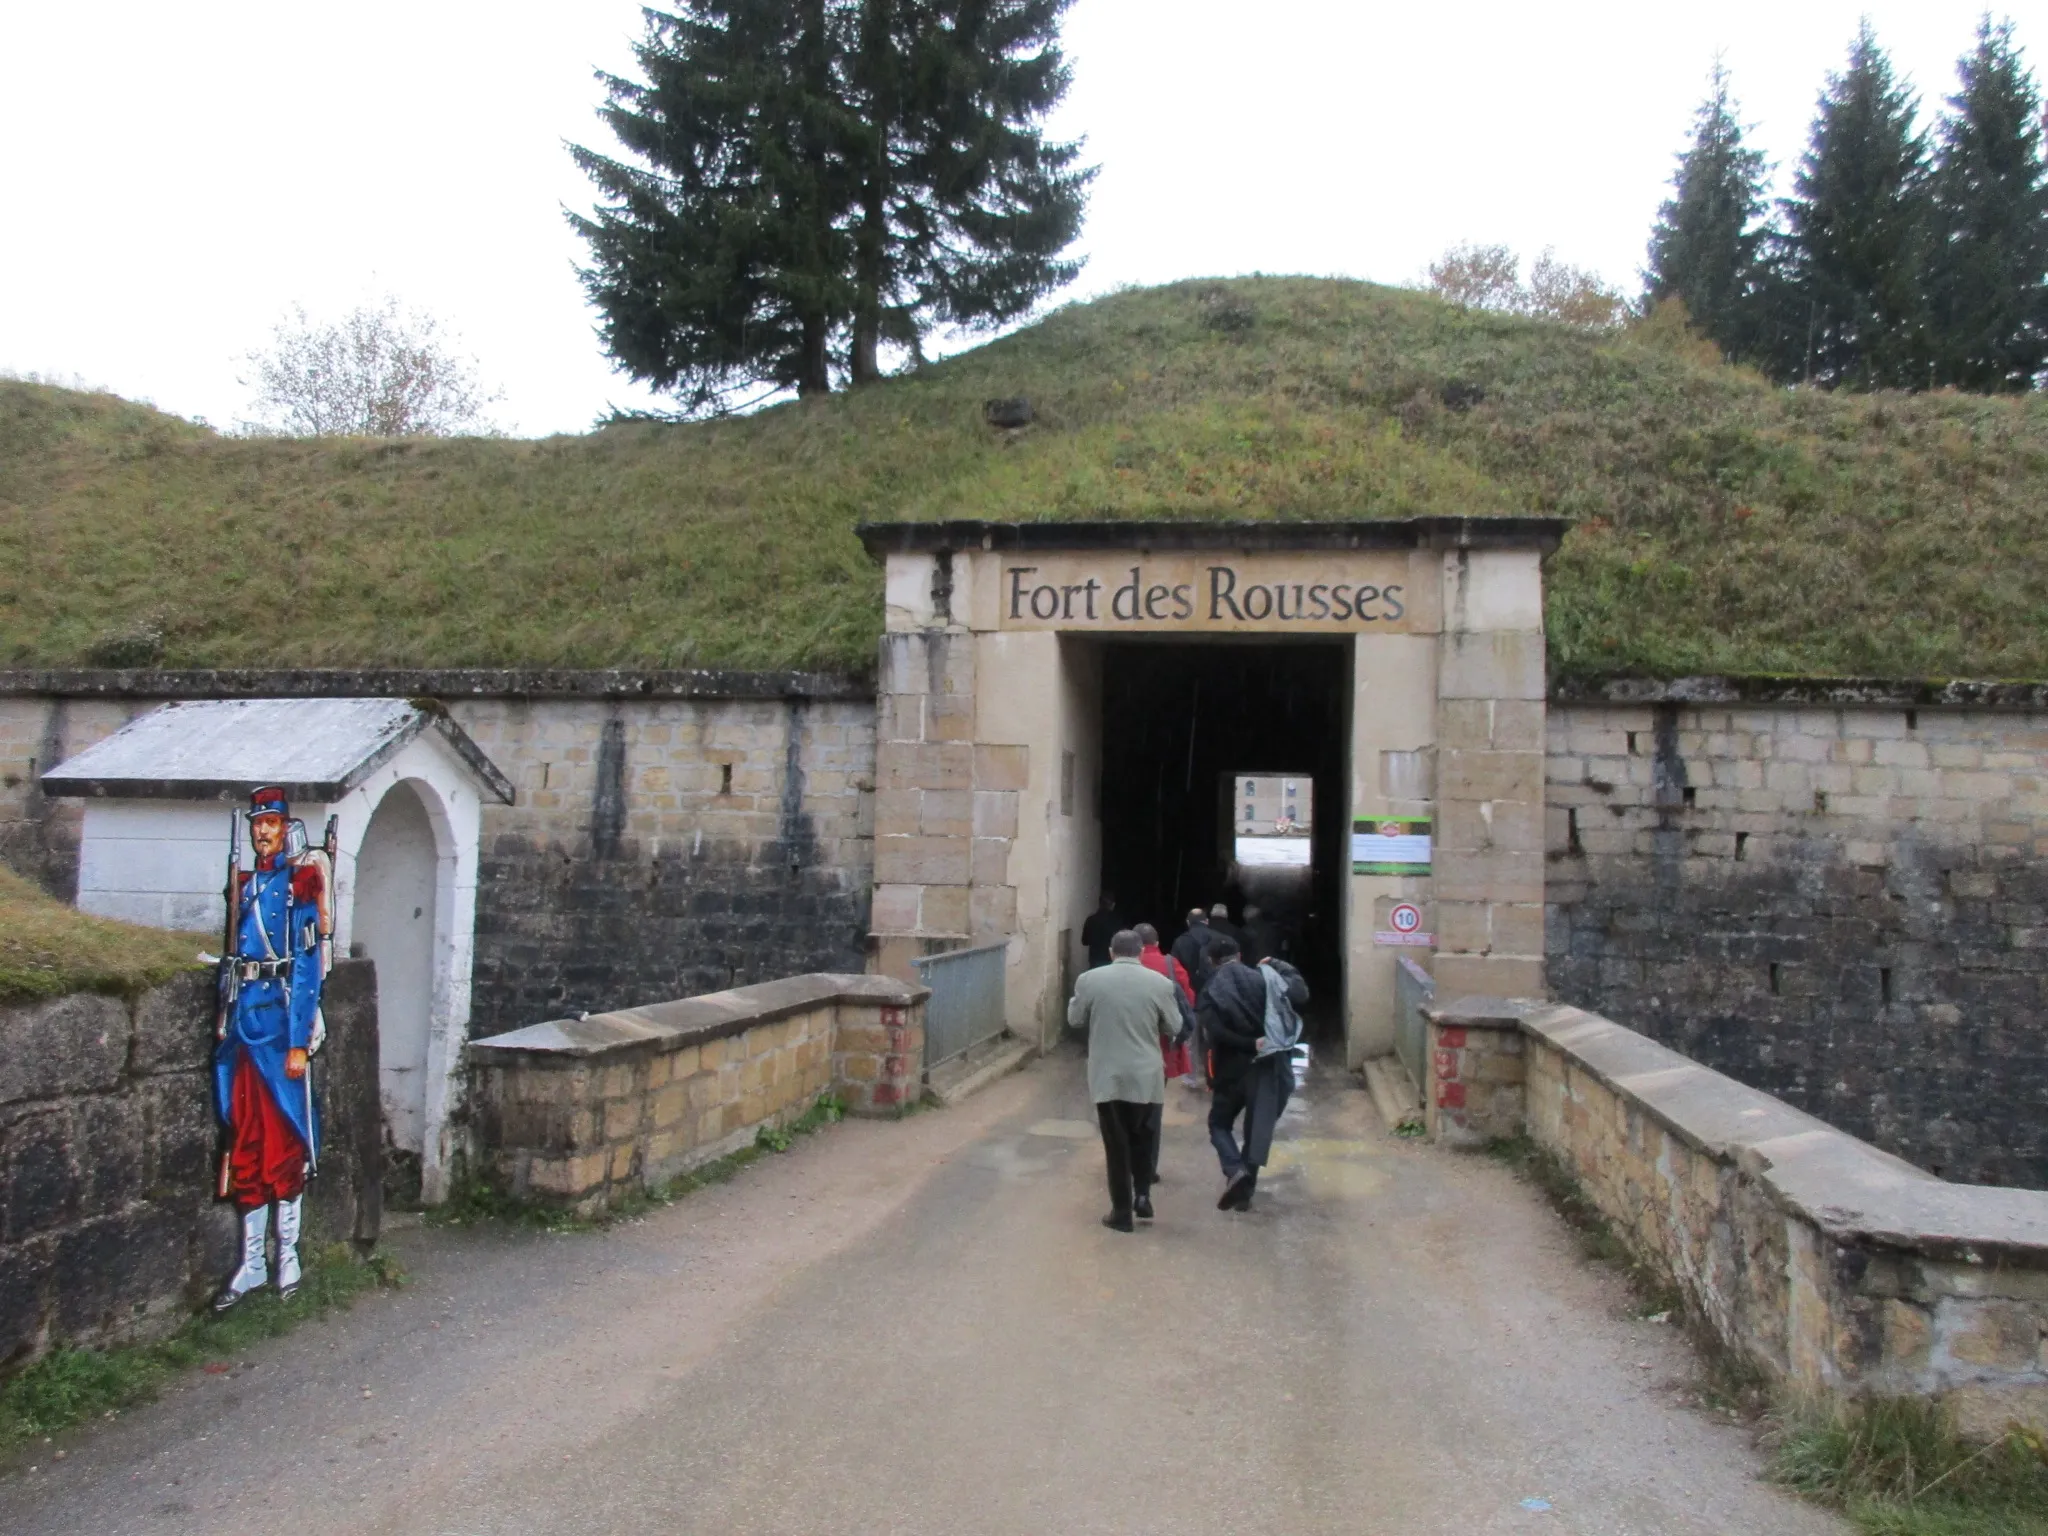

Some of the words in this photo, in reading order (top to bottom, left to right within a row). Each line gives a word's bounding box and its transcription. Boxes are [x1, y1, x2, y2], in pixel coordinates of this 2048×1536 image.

[1007, 567, 1101, 621] Fort
[1112, 566, 1194, 621] des
[1207, 566, 1405, 621] Rousses
[1398, 912, 1414, 926] 10
